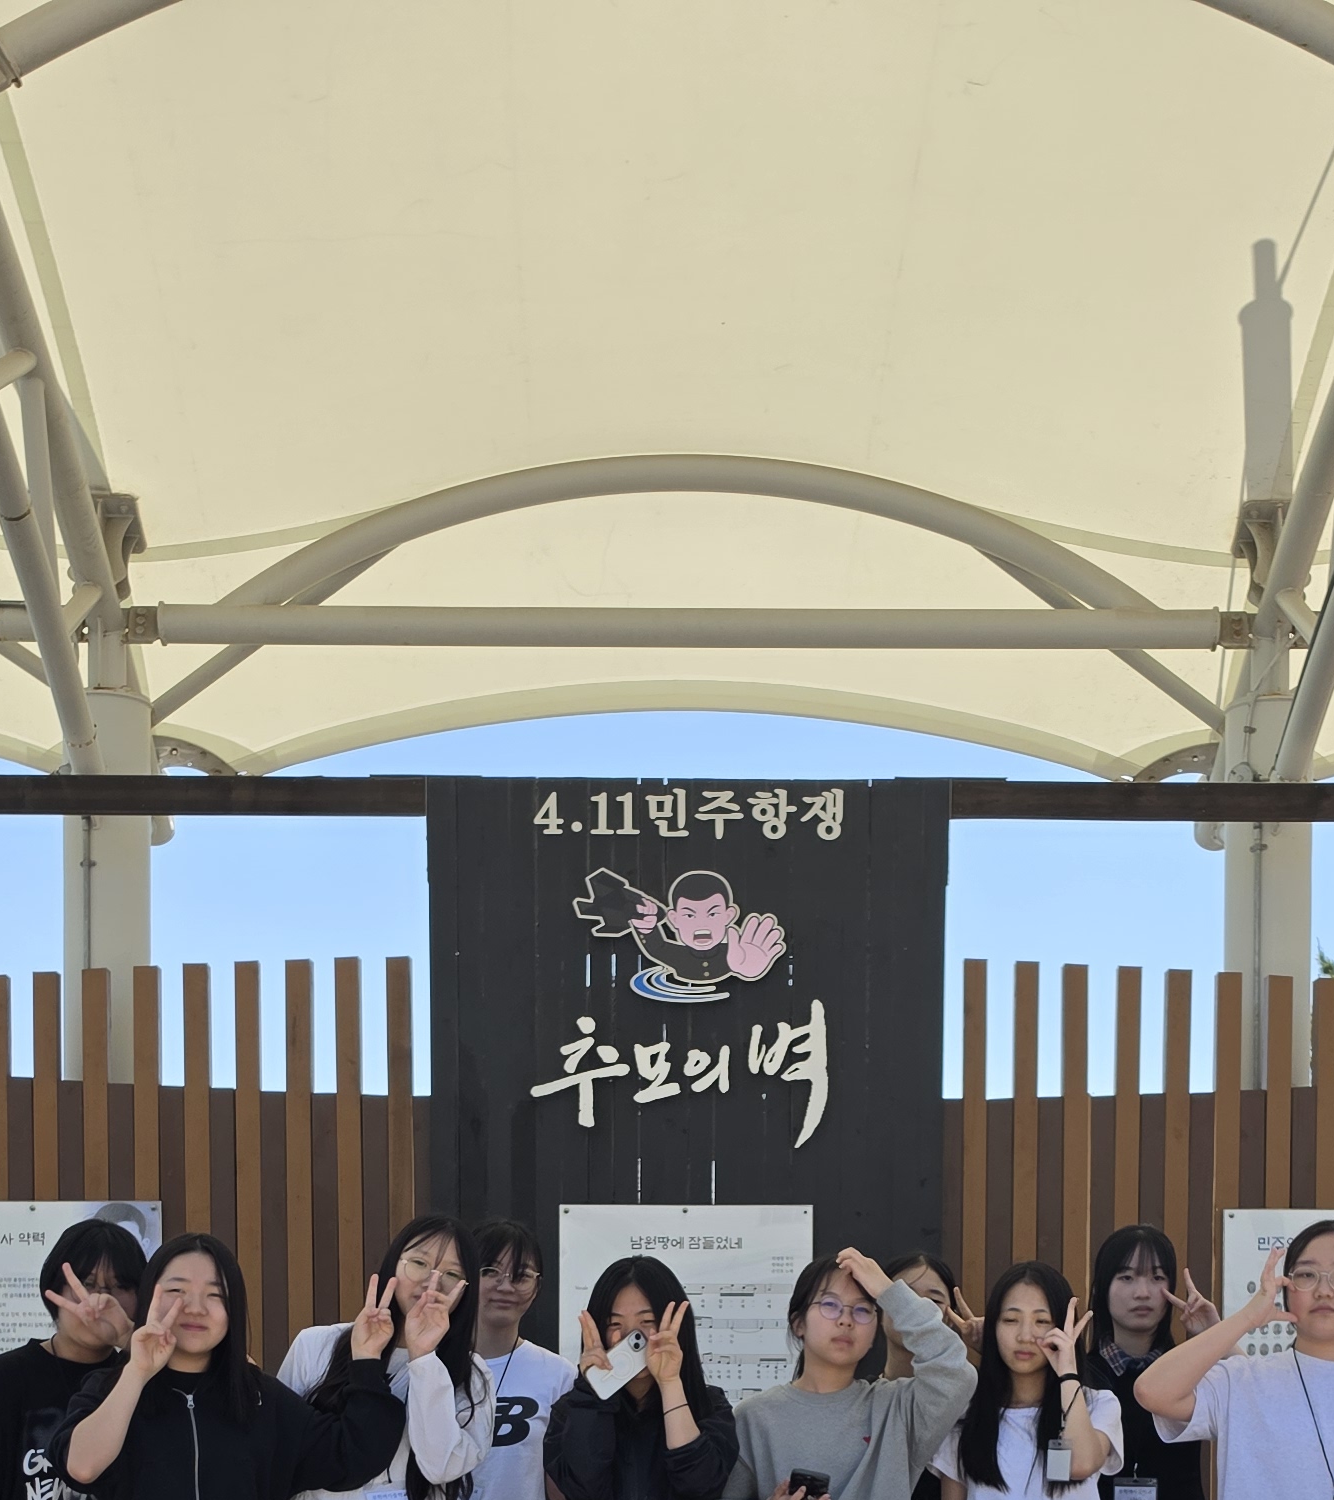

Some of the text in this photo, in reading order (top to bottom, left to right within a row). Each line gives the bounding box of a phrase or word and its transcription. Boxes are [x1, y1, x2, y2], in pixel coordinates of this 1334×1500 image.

[534, 788, 845, 841] 4.11민주항쟁
[530, 999, 829, 1149] 추모의 벽
[18, 1232, 46, 1246] 약력
[630, 1236, 743, 1250] 남원땅에 잠들었네
